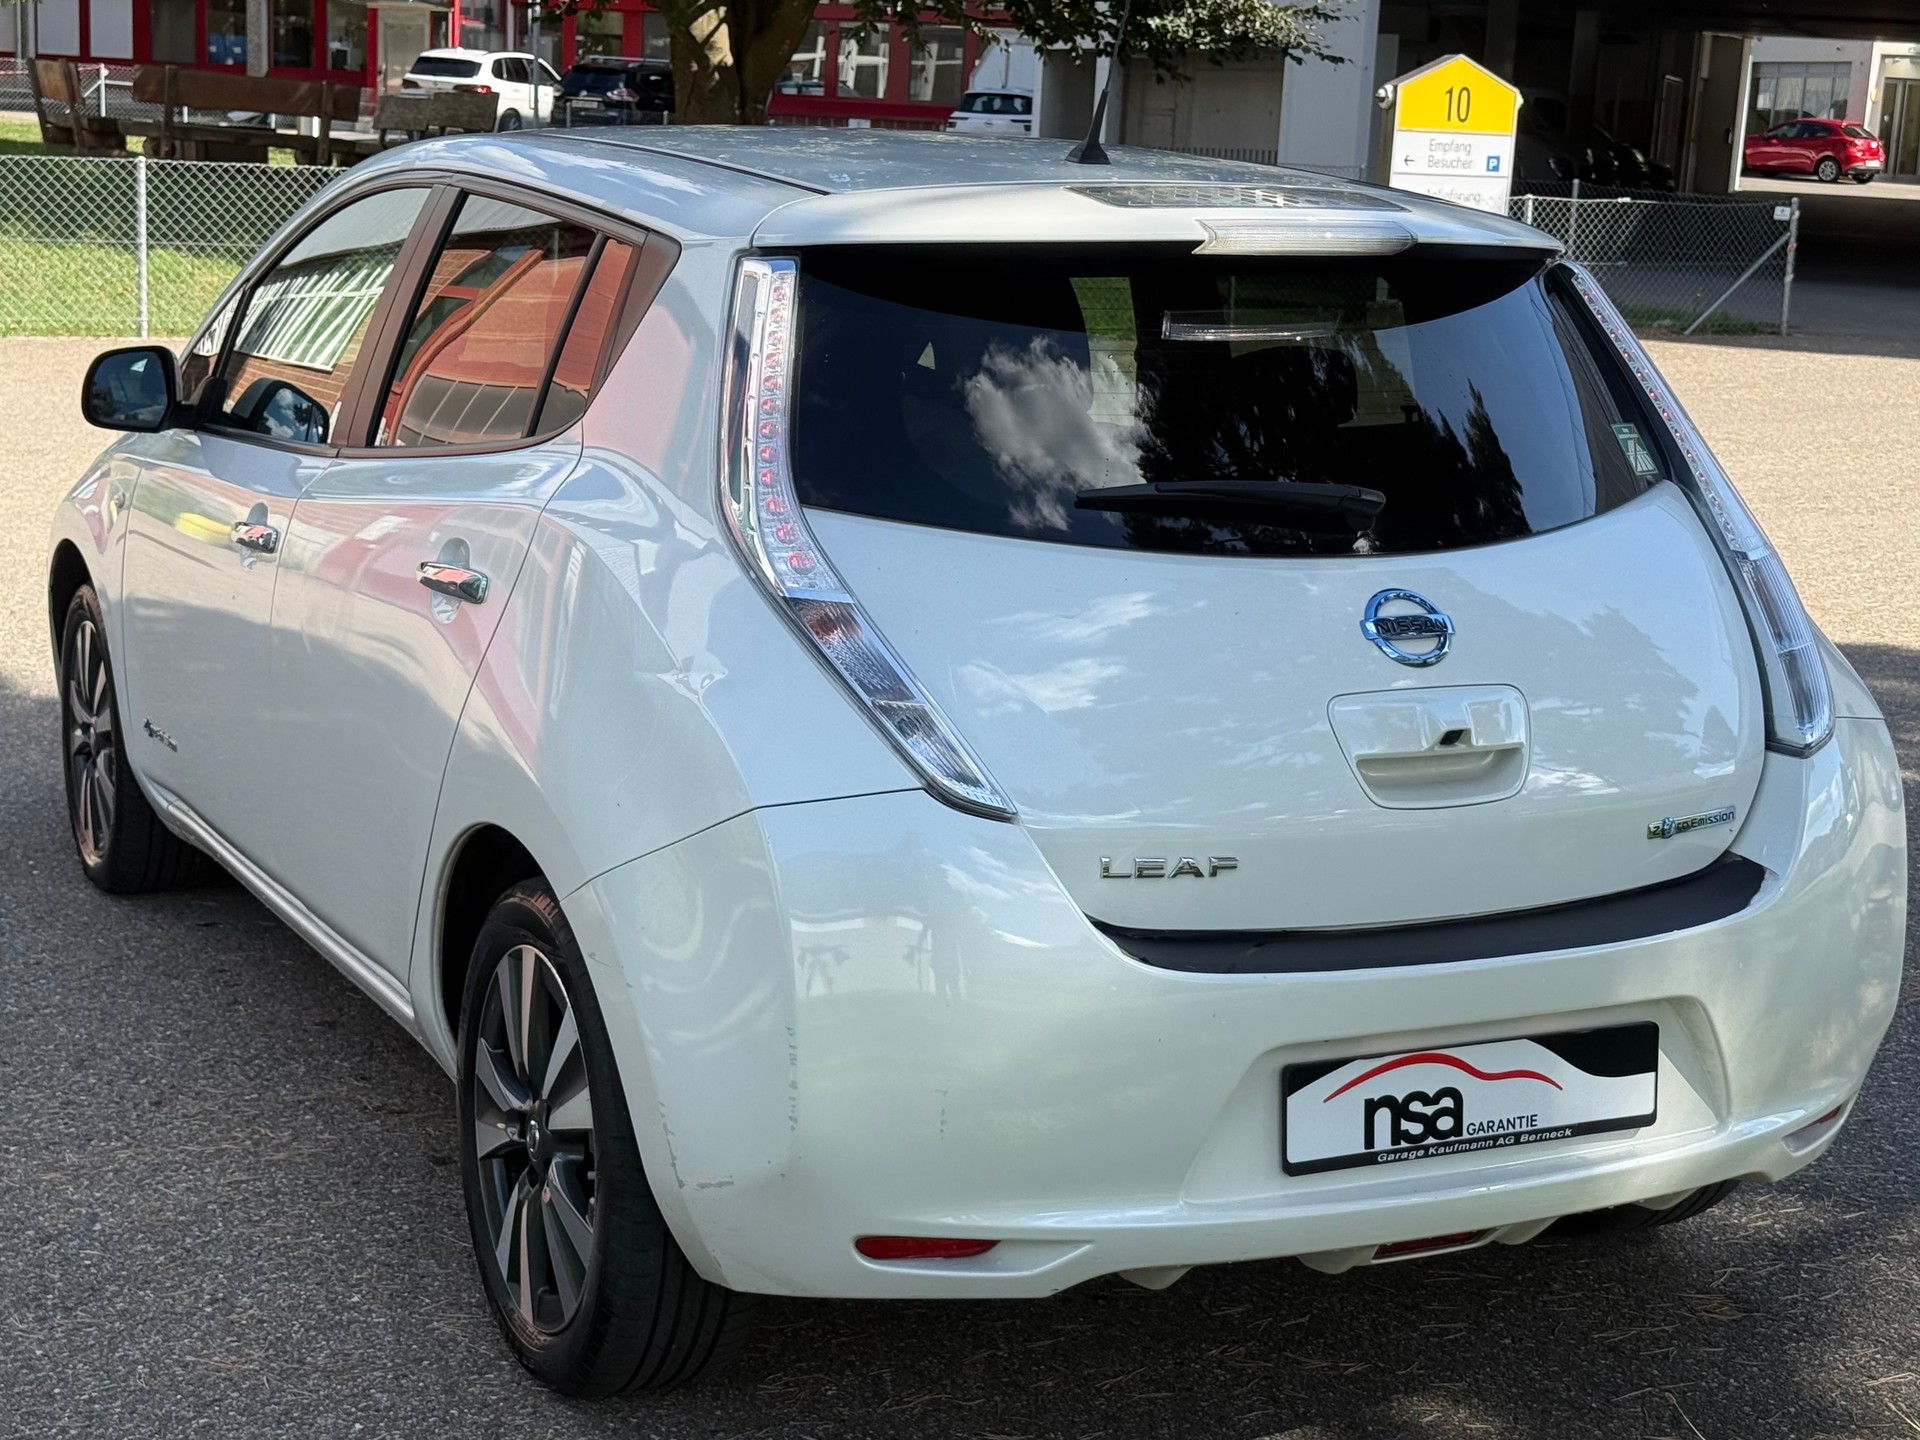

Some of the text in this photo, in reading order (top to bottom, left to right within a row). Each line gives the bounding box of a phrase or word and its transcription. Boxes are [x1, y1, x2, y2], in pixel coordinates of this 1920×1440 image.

[1444, 86, 1471, 123] 10
[1428, 138, 1472, 156] Empfang
[1427, 155, 1473, 169] Besucher
[1376, 617, 1448, 634] NISSAN
[1100, 856, 1240, 878] LEAF
[1364, 1086, 1463, 1149] nsa
[1466, 1114, 1538, 1136] GARANTIE
[1377, 1128, 1572, 1162] Garage Kaufmann AG Berneck
